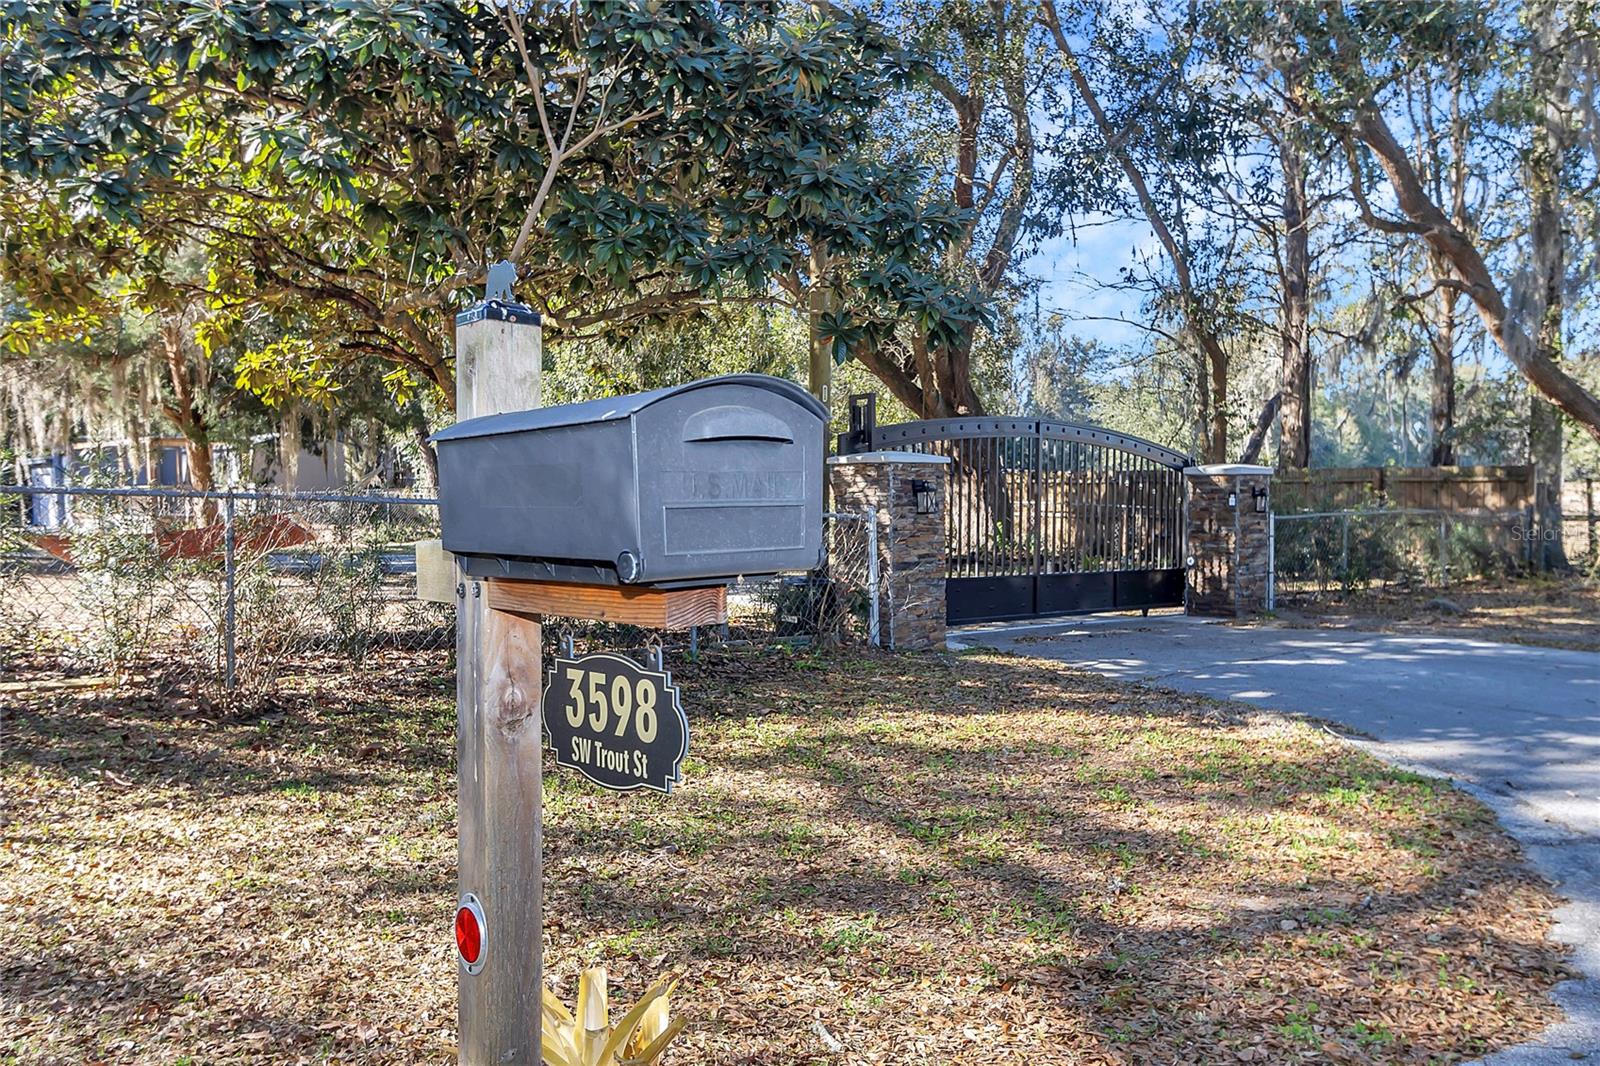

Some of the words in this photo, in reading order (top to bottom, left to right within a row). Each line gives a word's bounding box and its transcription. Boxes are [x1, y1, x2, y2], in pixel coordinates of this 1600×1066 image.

[565, 668, 658, 744] 3598
[571, 736, 592, 765] SW
[594, 741, 630, 775] Trout
[633, 749, 649, 779] St
